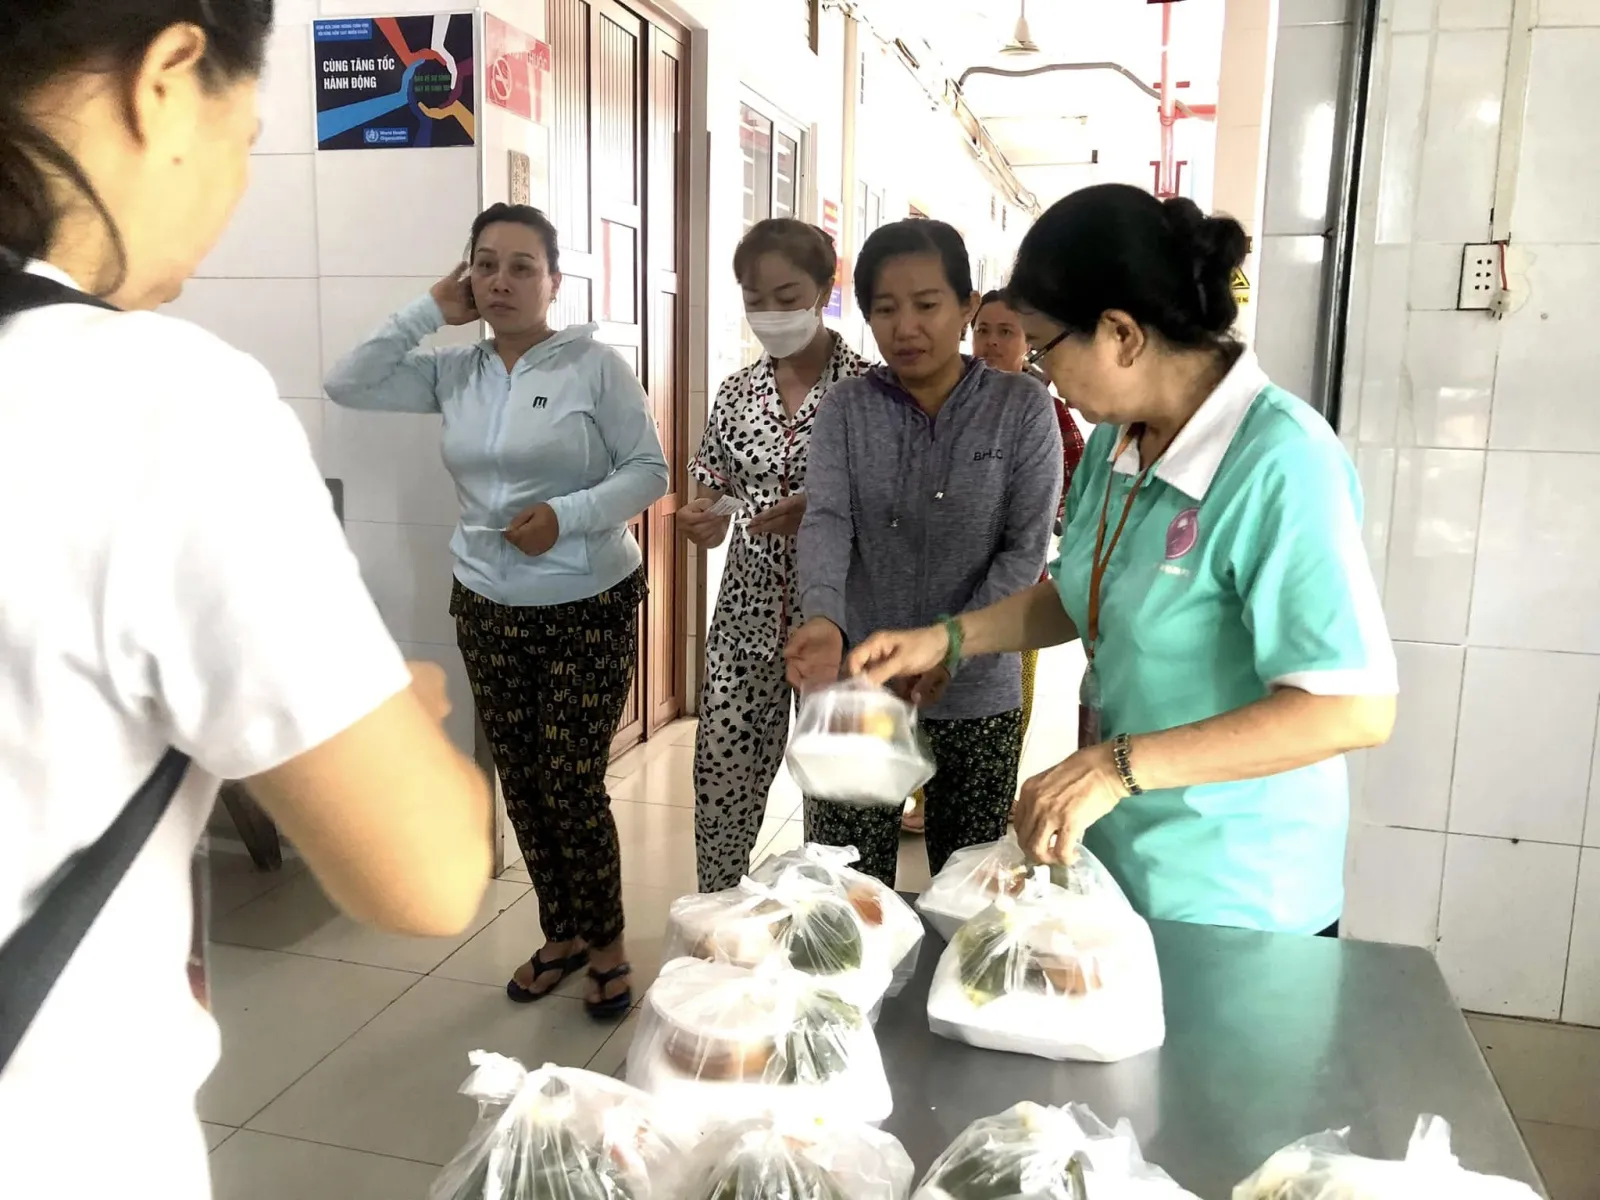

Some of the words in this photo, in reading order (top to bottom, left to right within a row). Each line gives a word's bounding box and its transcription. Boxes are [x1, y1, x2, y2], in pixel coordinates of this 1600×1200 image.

[323, 58, 348, 72] CÙNG
[350, 57, 375, 71] TĂNG
[377, 54, 395, 70] TỐC
[323, 75, 349, 90] HÀNH
[351, 75, 377, 91] ĐỘNG
